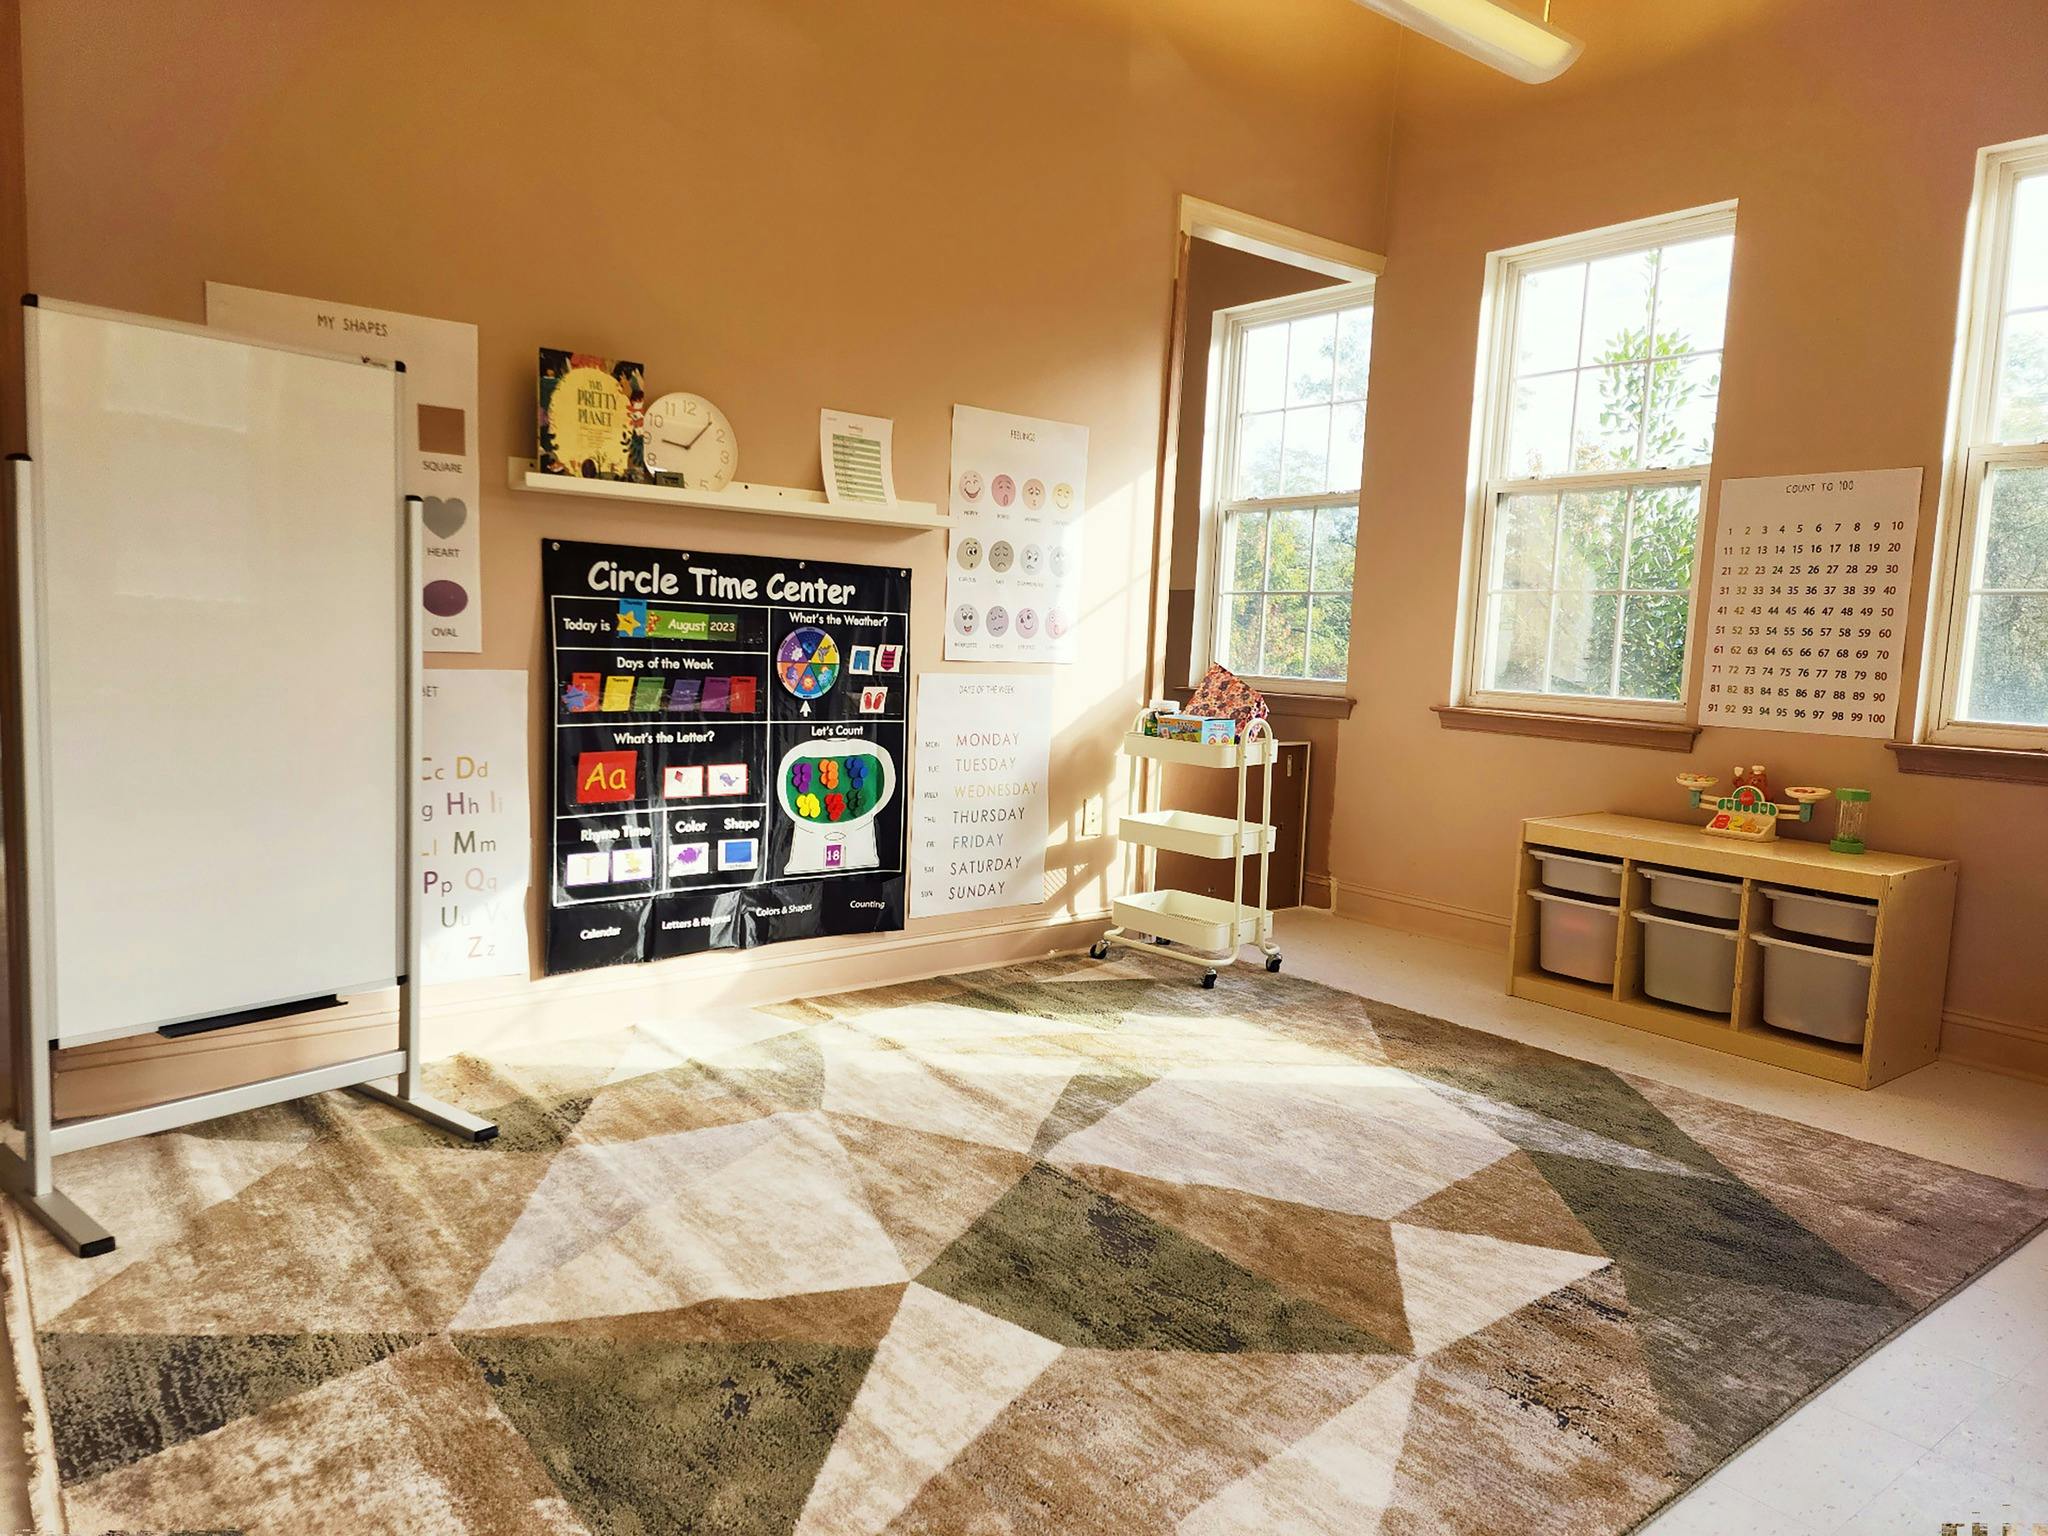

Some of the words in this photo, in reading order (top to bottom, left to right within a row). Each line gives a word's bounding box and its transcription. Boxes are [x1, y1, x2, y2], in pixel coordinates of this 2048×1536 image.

[316, 313, 335, 330] MY
[343, 318, 389, 337] SHAPES
[577, 388, 617, 411] PRETTY
[664, 401, 676, 417] 11
[683, 400, 697, 416] 12
[578, 408, 613, 427] PLANET
[648, 412, 664, 429] 10
[716, 429, 725, 443] 2
[1010, 429, 1037, 443] FEELINGS
[423, 460, 464, 474] SQUARE
[646, 452, 657, 467] 8
[1786, 483, 1816, 495] COUNT
[1821, 482, 1834, 493] TO
[1838, 480, 1855, 491] 100
[1744, 526, 1752, 536] 2
[1761, 525, 1769, 535] 3
[1778, 524, 1786, 534] 4
[1796, 524, 1804, 534] 5
[1815, 523, 1823, 533] 6
[1834, 522, 1842, 533] 7
[1853, 521, 1861, 532] 8
[1873, 521, 1881, 531] 9
[1891, 520, 1904, 531] 10
[427, 547, 460, 559] HEART
[1723, 546, 1733, 555] 11
[1740, 546, 1751, 556] 12
[1757, 545, 1768, 555] 13
[1775, 545, 1786, 555] 14
[1792, 544, 1804, 554] 15
[1811, 544, 1823, 554] 16
[1829, 543, 1842, 553] 17
[1848, 543, 1861, 553] 18
[1869, 542, 1881, 553] 19
[1887, 542, 1901, 553] 20
[1721, 566, 1732, 576] 21
[1737, 566, 1750, 576] 22
[1754, 565, 1766, 575] 23
[1771, 565, 1784, 575] 24
[1789, 565, 1801, 575] 25
[1807, 564, 1820, 575] 26
[1826, 564, 1839, 575] 27
[1845, 564, 1858, 574] 28
[1864, 564, 1878, 574] 29
[1885, 564, 1899, 574] 30
[587, 560, 679, 595] Circle
[687, 566, 758, 600] Time
[766, 573, 856, 605] Center
[1719, 586, 1730, 596] 31
[1736, 585, 1748, 596] 32
[1752, 585, 1764, 595] 33
[1769, 585, 1782, 595] 34
[1786, 585, 1799, 595] 35
[1805, 585, 1818, 595] 36
[1823, 585, 1837, 595] 37
[1842, 585, 1856, 595] 38
[1862, 585, 1876, 595] 39
[1883, 585, 1897, 595] 40
[562, 617, 597, 633] Today
[600, 618, 611, 631] is
[668, 618, 707, 634] August
[709, 621, 736, 632] 2023
[789, 611, 824, 624] What's
[826, 613, 842, 625] the
[844, 614, 889, 627] Weather?
[431, 627, 459, 639] OVAL
[1715, 625, 1726, 635] 51
[1731, 625, 1743, 635] 52
[1748, 626, 1760, 636] 53
[1765, 626, 1778, 636] 54
[1783, 626, 1795, 637] 55
[1801, 627, 1814, 637] 56
[1819, 627, 1833, 637] 57
[1838, 627, 1852, 638] 58
[1857, 628, 1872, 638] 59
[1878, 628, 1892, 639] 60
[616, 656, 644, 671] Days
[647, 657, 660, 669] of
[661, 657, 680, 669] the
[682, 657, 714, 670] Week
[1711, 664, 1722, 674] 71
[1728, 664, 1740, 675] 72
[1745, 665, 1756, 675] 73
[1762, 666, 1774, 676] 74
[1780, 667, 1792, 677] 75
[1797, 667, 1810, 678] 76
[1815, 669, 1829, 679] 77
[1834, 669, 1848, 680] 78
[1854, 670, 1867, 681] 79
[1874, 671, 1888, 682] 80
[1710, 683, 1721, 693] 81
[1726, 684, 1738, 695] 82
[1743, 685, 1755, 696] 83
[1760, 686, 1772, 696] 84
[1777, 687, 1790, 697] 85
[1795, 688, 1808, 698] 86
[1813, 689, 1827, 699] 87
[1832, 690, 1846, 701] 88
[1852, 691, 1866, 701] 89
[1872, 692, 1886, 703] 90
[1707, 703, 1718, 713] 91
[1724, 704, 1737, 714] 92
[1742, 705, 1754, 715] 93
[1759, 706, 1771, 716] 94
[1776, 707, 1788, 717] 95
[1793, 708, 1806, 719] 96
[1812, 709, 1825, 720] 97
[1831, 710, 1844, 721] 98
[1850, 712, 1864, 722] 99
[1868, 713, 1886, 724] 100
[613, 731, 654, 746] What's
[656, 731, 675, 744] the
[677, 730, 715, 744] Letter?
[811, 725, 834, 738] Let's
[835, 725, 863, 738] Count
[955, 732, 1020, 748] MONDAY
[455, 756, 489, 780] Dd
[956, 757, 1016, 772] TUESDAY
[583, 762, 628, 792] Aa
[954, 781, 1039, 799] WEDNESDAY
[446, 792, 480, 816] Hh
[953, 807, 1025, 824] THURSDAY
[675, 820, 708, 834] Color
[723, 817, 760, 832] Shape
[453, 831, 497, 855] Mm
[580, 828, 621, 843] Rhyme
[952, 833, 1004, 849] FRIDAY
[826, 849, 841, 862] 18
[950, 856, 1022, 876] SATURDAY
[423, 871, 453, 897] Pp
[948, 881, 1006, 900] SUNDAY
[755, 906, 781, 918] Colors
[782, 905, 788, 915] &
[789, 902, 813, 915] Shapes
[850, 900, 886, 911] Counting
[661, 919, 692, 931] Letters
[693, 918, 700, 927] &
[700, 914, 732, 927] Rhymes
[579, 926, 622, 941] Calendar
